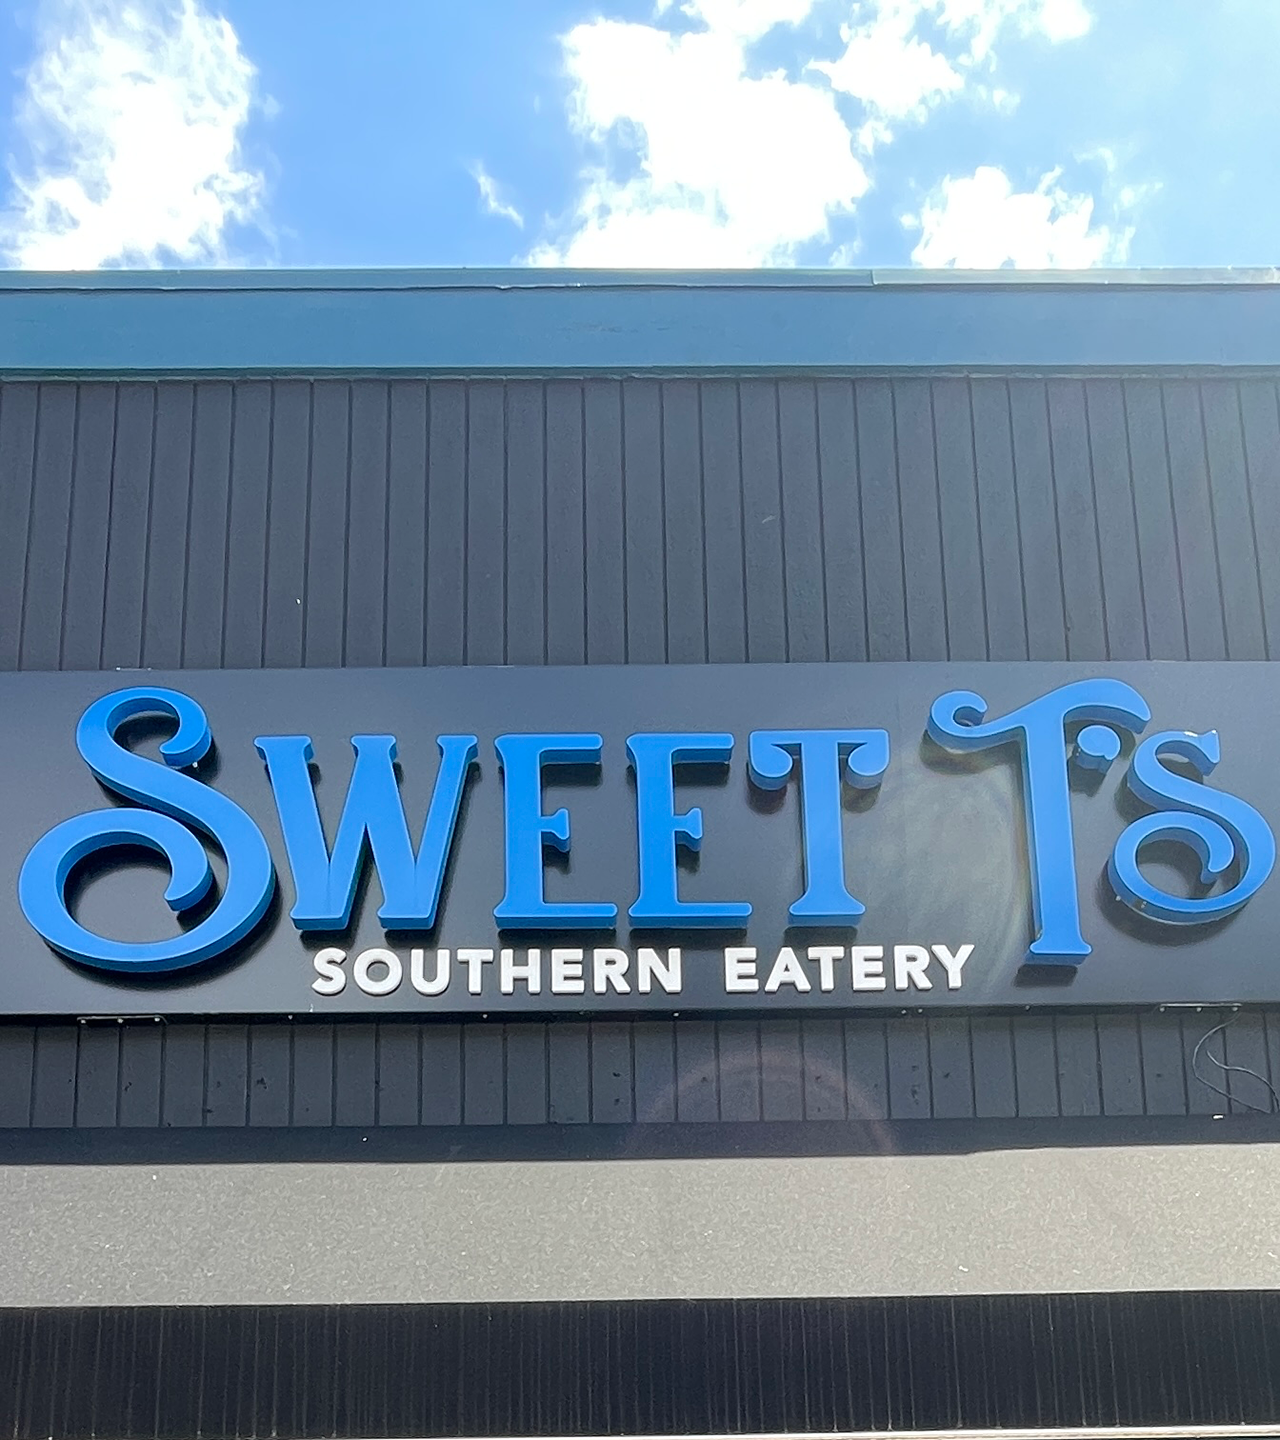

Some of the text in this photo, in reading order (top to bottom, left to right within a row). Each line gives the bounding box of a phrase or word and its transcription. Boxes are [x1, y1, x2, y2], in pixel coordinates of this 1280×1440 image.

[18, 685, 891, 973] SWEET
[310, 943, 976, 996] SOUTHERN EATERY
